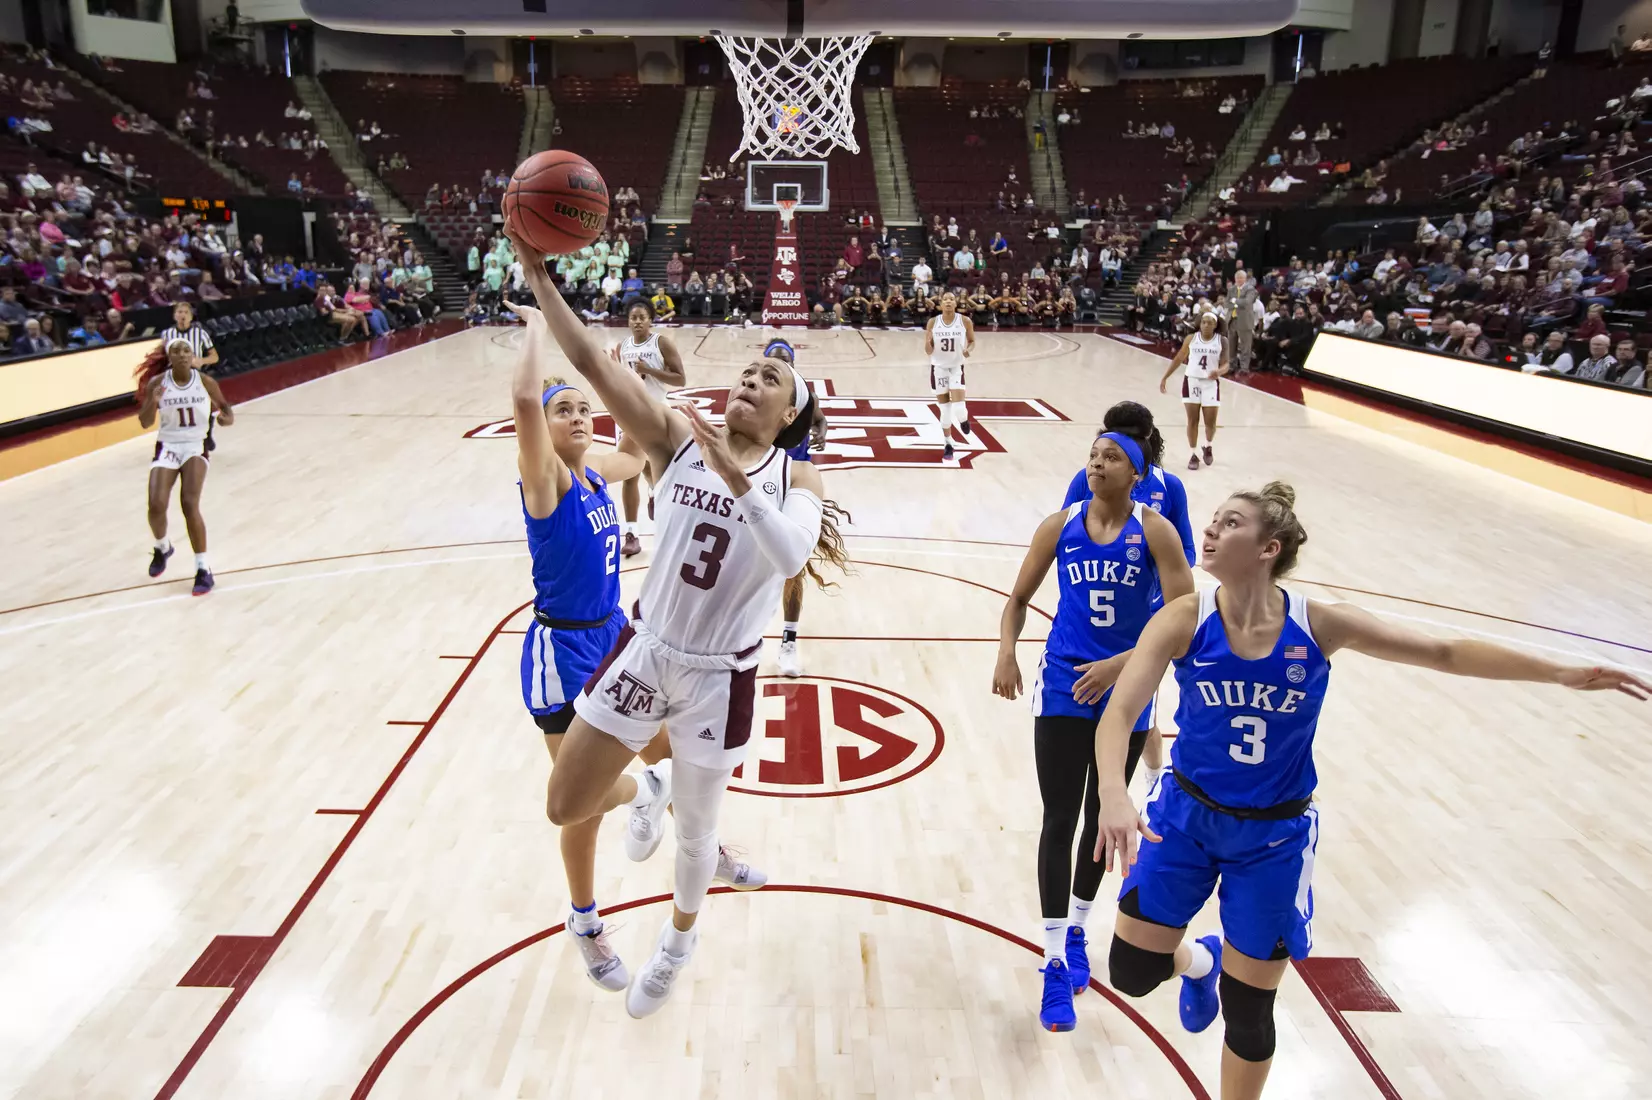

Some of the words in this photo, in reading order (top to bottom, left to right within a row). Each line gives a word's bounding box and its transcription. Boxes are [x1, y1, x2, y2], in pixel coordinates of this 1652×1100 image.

[770, 291, 801, 299] WELLS
[771, 299, 801, 307] FARGO
[761, 310, 809, 321] OPPORTUNE
[941, 338, 955, 352] 31
[1198, 355, 1208, 370] 4
[163, 396, 189, 406] TEXAS
[177, 407, 196, 427] 11
[672, 484, 735, 518] TEXAS
[587, 503, 620, 535] DUK
[605, 534, 617, 576] 2
[680, 522, 731, 591] 3
[1066, 560, 1141, 587] DUKE
[1089, 589, 1116, 627] 5
[1195, 680, 1307, 713] DUKE
[1228, 715, 1267, 765] 3
